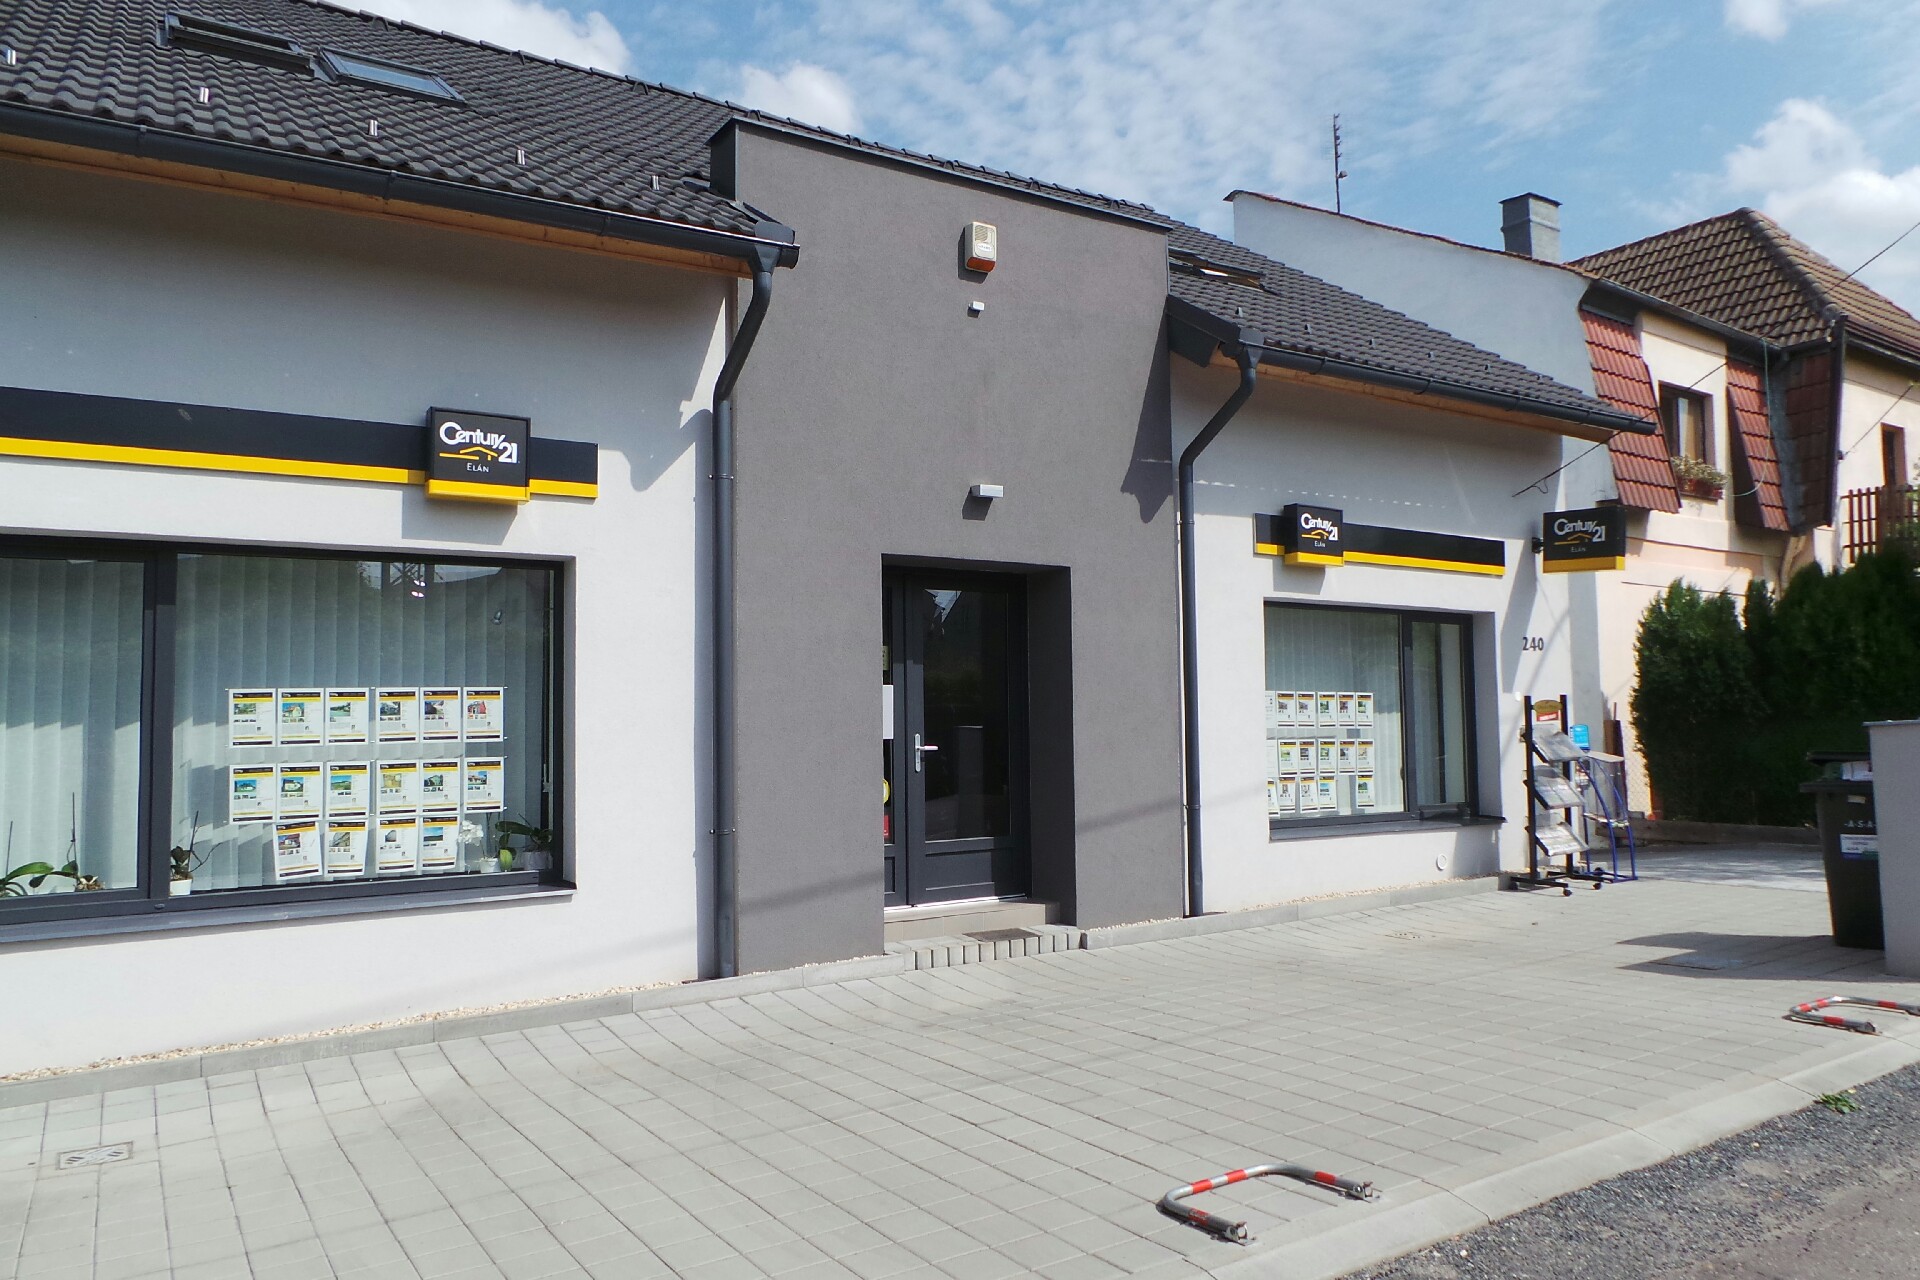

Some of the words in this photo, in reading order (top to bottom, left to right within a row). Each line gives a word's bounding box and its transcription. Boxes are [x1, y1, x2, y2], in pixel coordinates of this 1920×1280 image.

[439, 421, 506, 450] Century
[498, 442, 519, 464] 21
[1300, 513, 1332, 532] Century
[1328, 526, 1339, 541] 21
[1554, 518, 1598, 536] Century
[1592, 525, 1606, 542] 21
[1522, 636, 1545, 651] 240
